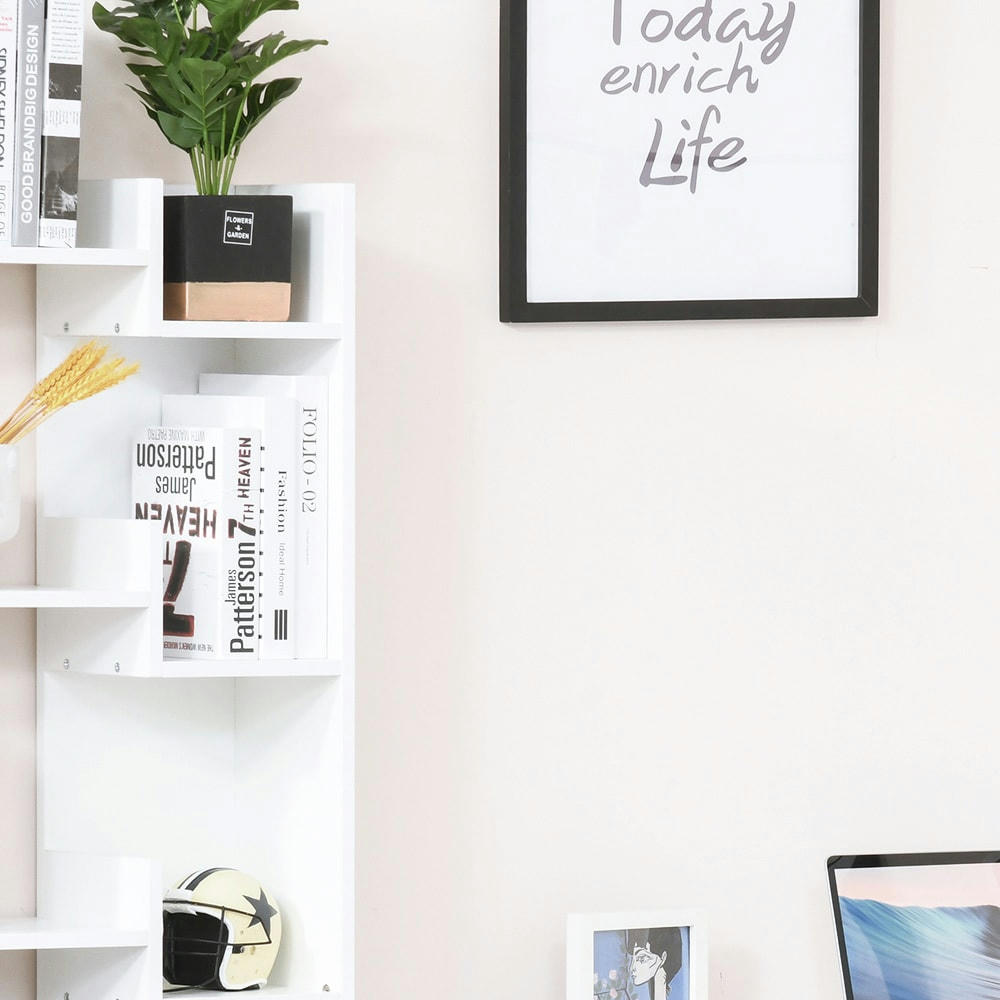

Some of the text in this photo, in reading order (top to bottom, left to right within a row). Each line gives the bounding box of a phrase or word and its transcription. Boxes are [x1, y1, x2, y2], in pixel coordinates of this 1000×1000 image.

[26, 24, 39, 86] DESIGN
[599, 41, 759, 95] enrich
[639, 104, 748, 195] Life
[21, 175, 34, 224] GOOD
[226, 216, 252, 225] FLOWERS
[227, 231, 249, 239] GARDEN
[136, 443, 216, 480] Patterson
[237, 437, 251, 499] HEAVEN
[155, 475, 196, 502] James
[277, 470, 288, 534] Fashion
[225, 569, 237, 606] James
[230, 542, 256, 653] Patterson
